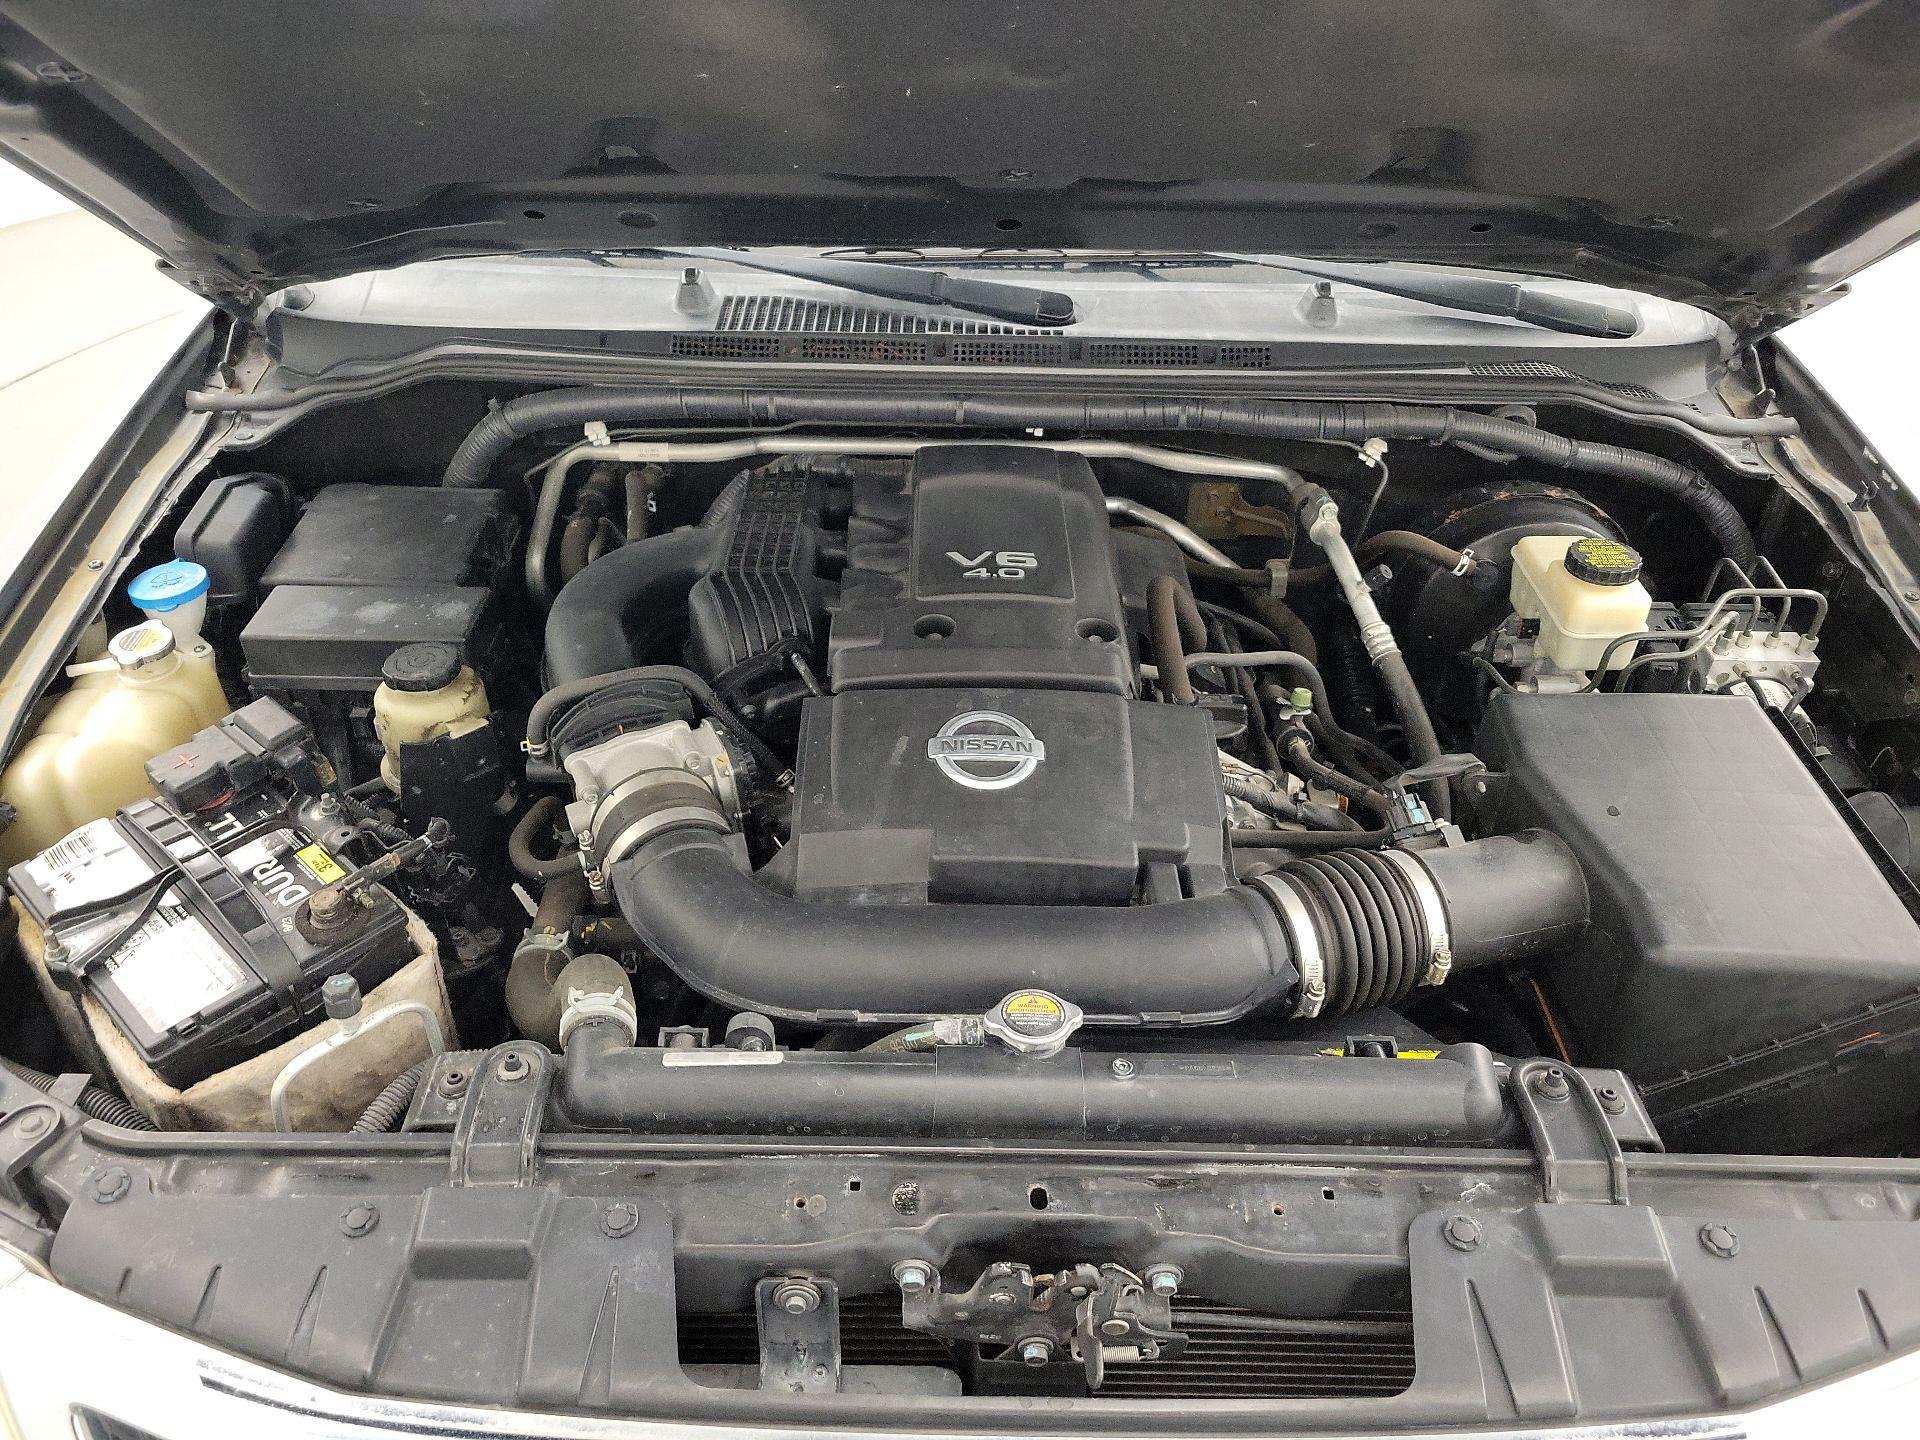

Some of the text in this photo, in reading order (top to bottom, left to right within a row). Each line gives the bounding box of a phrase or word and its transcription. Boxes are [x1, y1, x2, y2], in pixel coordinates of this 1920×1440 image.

[945, 551, 1038, 567] V6
[962, 568, 1025, 579] 4.0
[941, 739, 1033, 753] NISSAN
